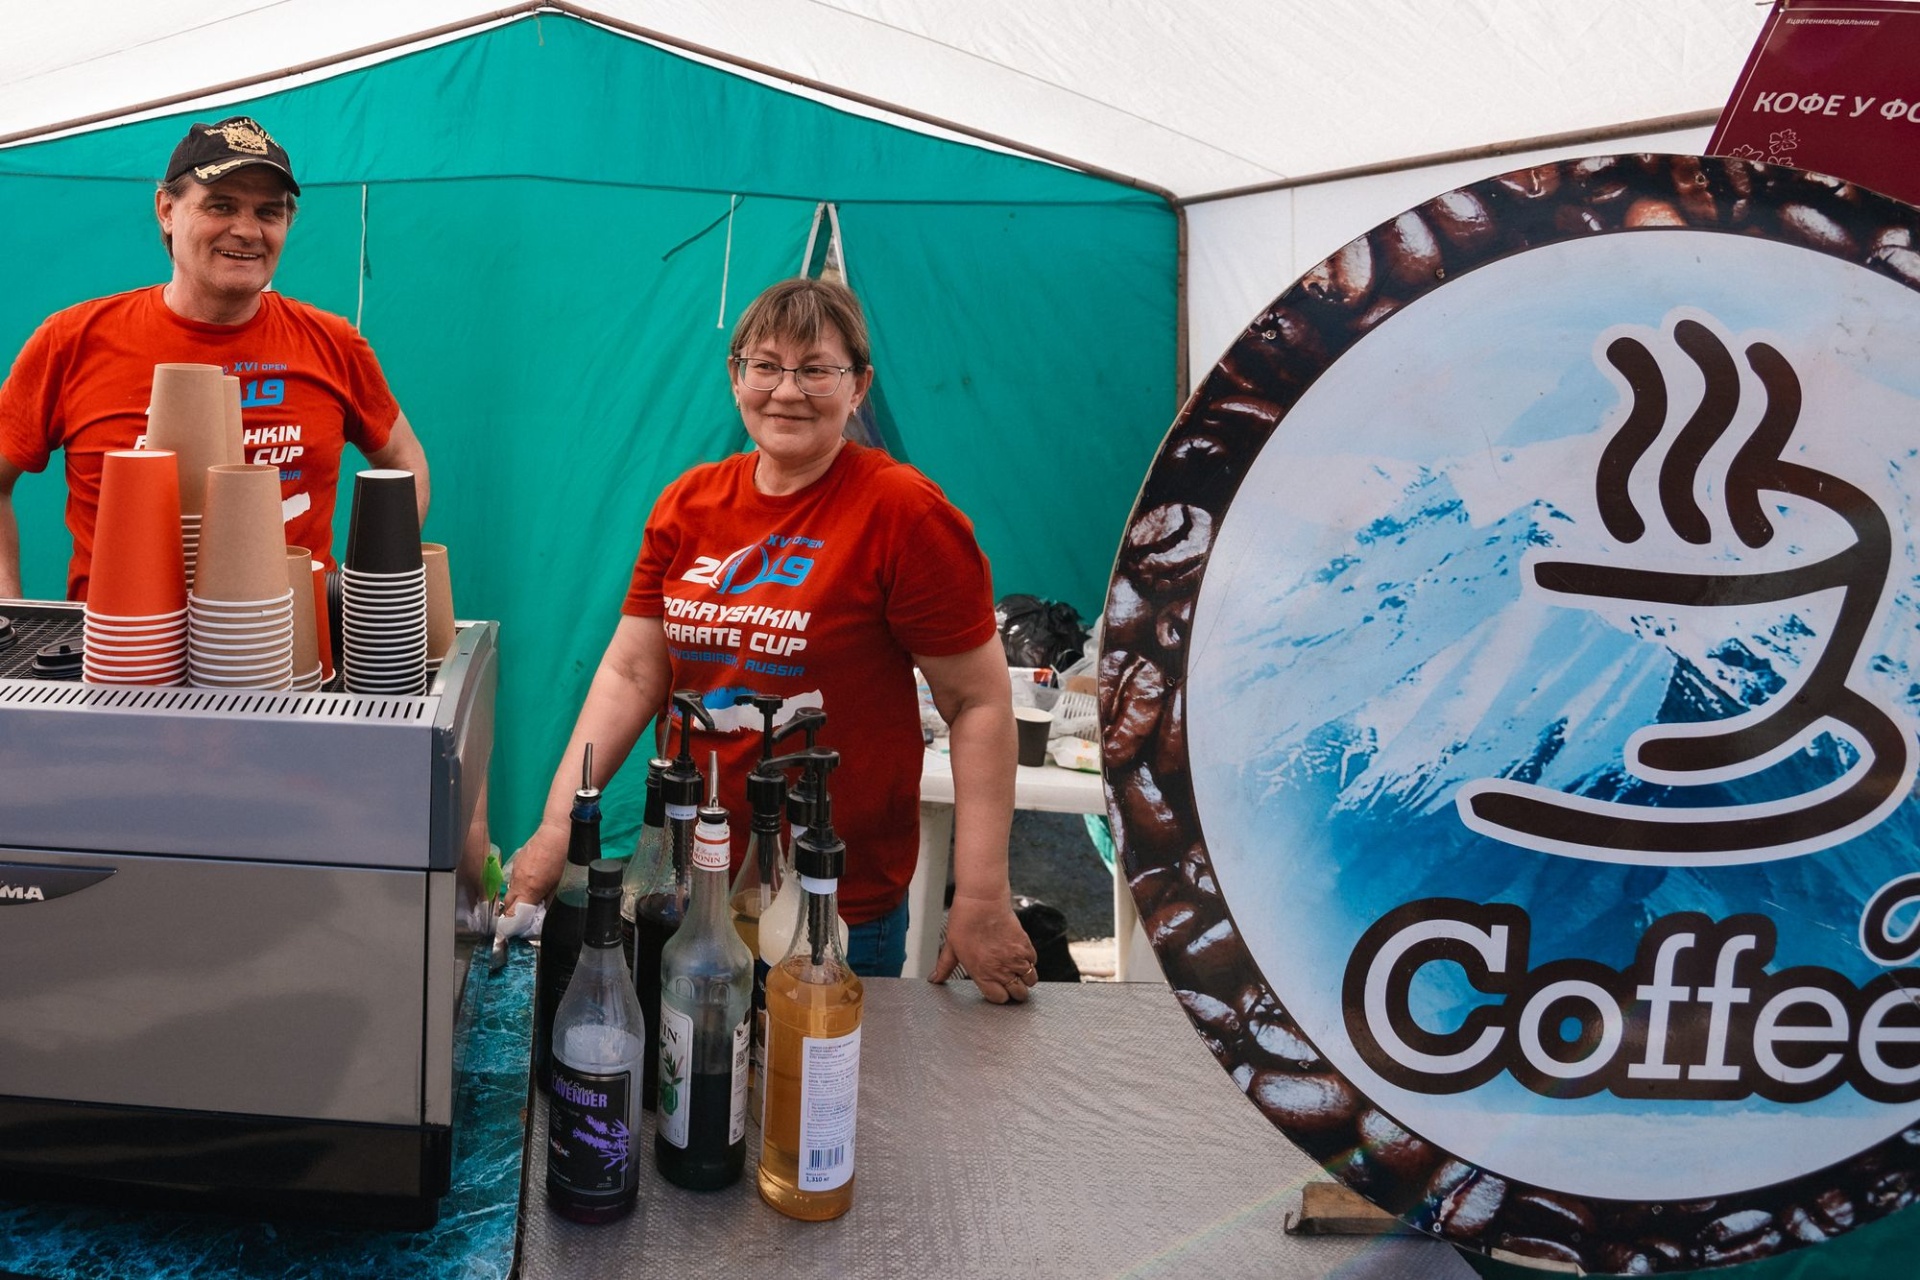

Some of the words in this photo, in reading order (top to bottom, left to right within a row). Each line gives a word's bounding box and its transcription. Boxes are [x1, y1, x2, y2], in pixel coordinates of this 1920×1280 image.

[1785, 17, 1880, 27] #цветениемаральника
[1753, 92, 1845, 115] КОФЕ
[1849, 96, 1876, 117] У
[234, 362, 258, 372] XVI
[261, 362, 288, 371] OPEN
[240, 378, 285, 408] 19
[253, 446, 304, 466] CUP
[279, 470, 302, 481] SIA
[791, 536, 826, 549] OPEN
[749, 631, 808, 657] CUP
[744, 659, 805, 676] RUSSIA
